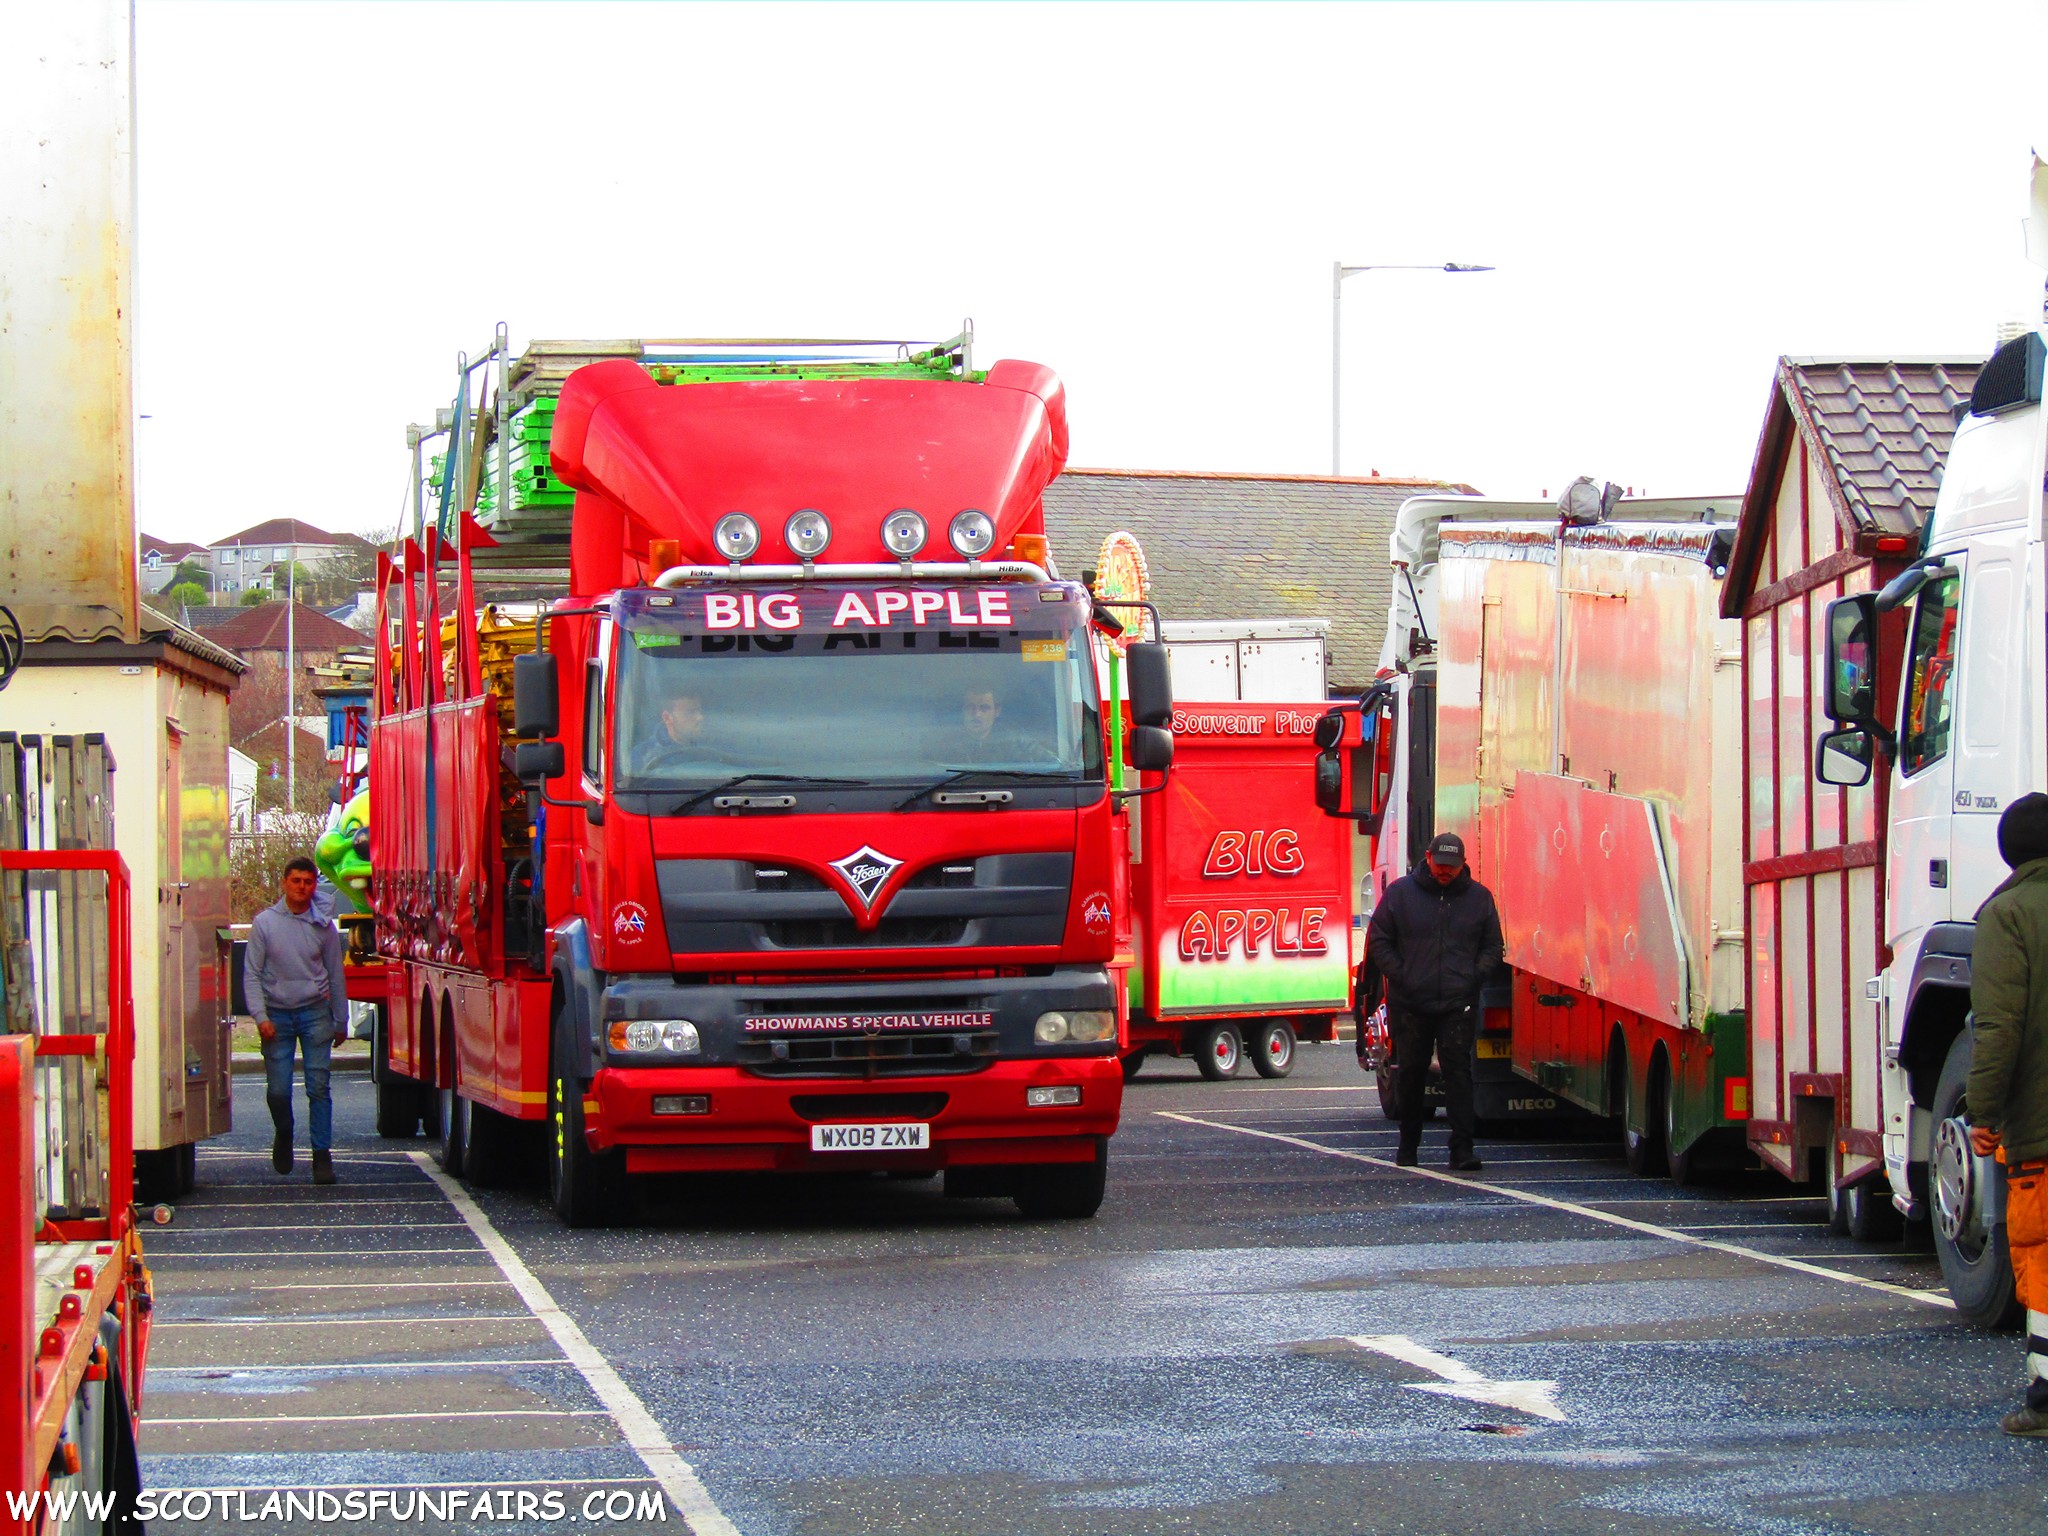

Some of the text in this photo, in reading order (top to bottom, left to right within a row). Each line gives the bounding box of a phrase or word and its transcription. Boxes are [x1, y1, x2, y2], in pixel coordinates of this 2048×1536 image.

[704, 591, 1013, 630] BIG APPLE
[1042, 643, 1063, 653] 236
[1171, 709, 1321, 735] Souvenir Pho
[1203, 828, 1305, 878] BIG
[851, 864, 889, 885] Foden
[1180, 906, 1329, 959] APPLE
[745, 1013, 991, 1031] SHOWMANS SPECIAL VEHICLE
[1508, 1098, 1557, 1110] IVECO
[881, 1126, 921, 1146] ZXW
